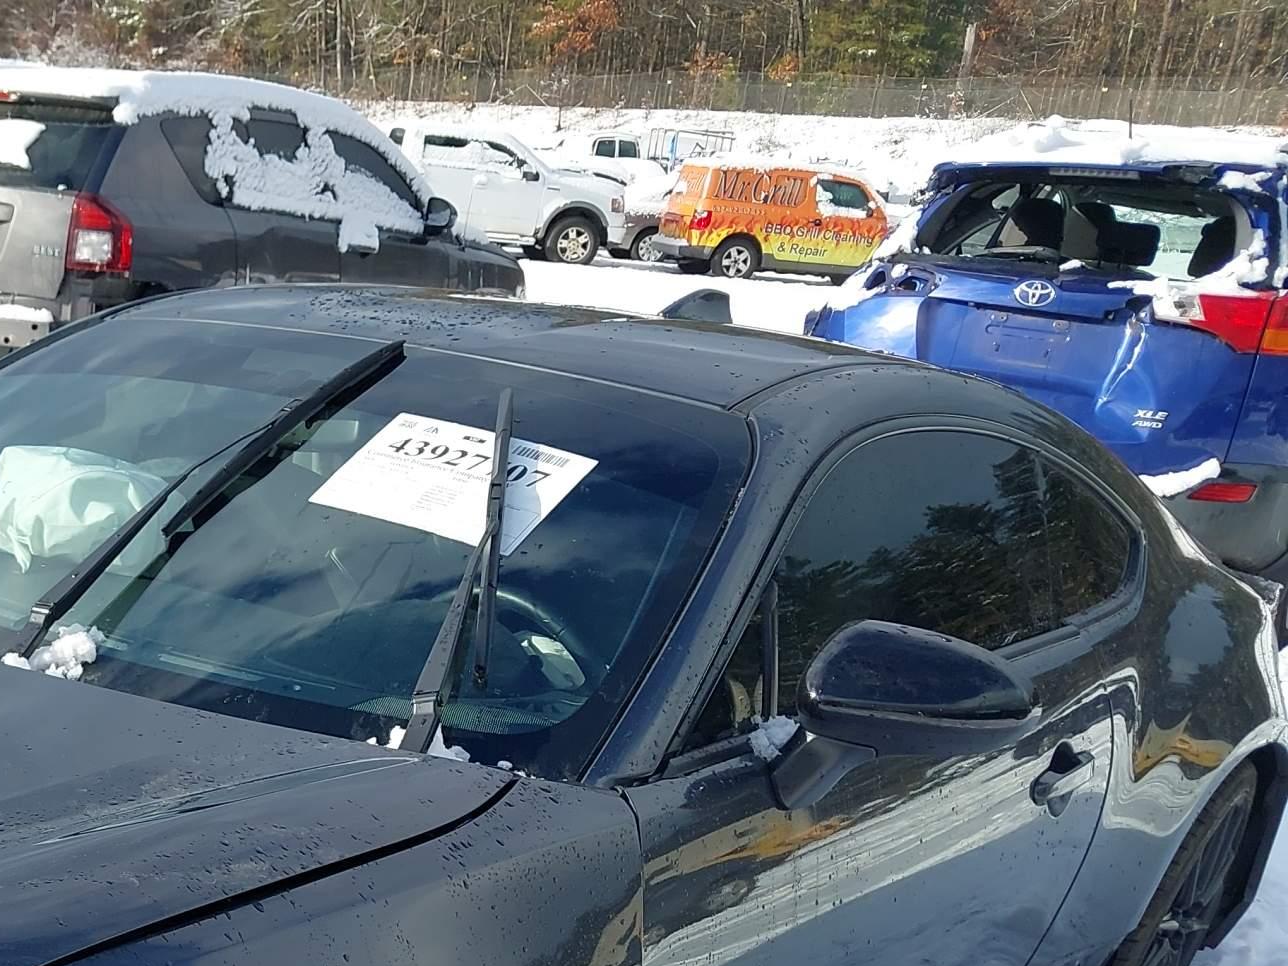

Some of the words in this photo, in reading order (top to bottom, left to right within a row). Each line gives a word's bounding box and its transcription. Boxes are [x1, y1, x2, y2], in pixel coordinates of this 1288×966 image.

[751, 172, 804, 208] Grill
[764, 222, 792, 238] BBQ
[795, 226, 822, 241] Grill
[822, 229, 874, 248] Cleaning
[776, 241, 786, 252] &
[789, 243, 828, 258] Repair
[1131, 420, 1163, 429] AWD
[1134, 409, 1169, 420] XLE
[388, 437, 553, 488] 4392707
